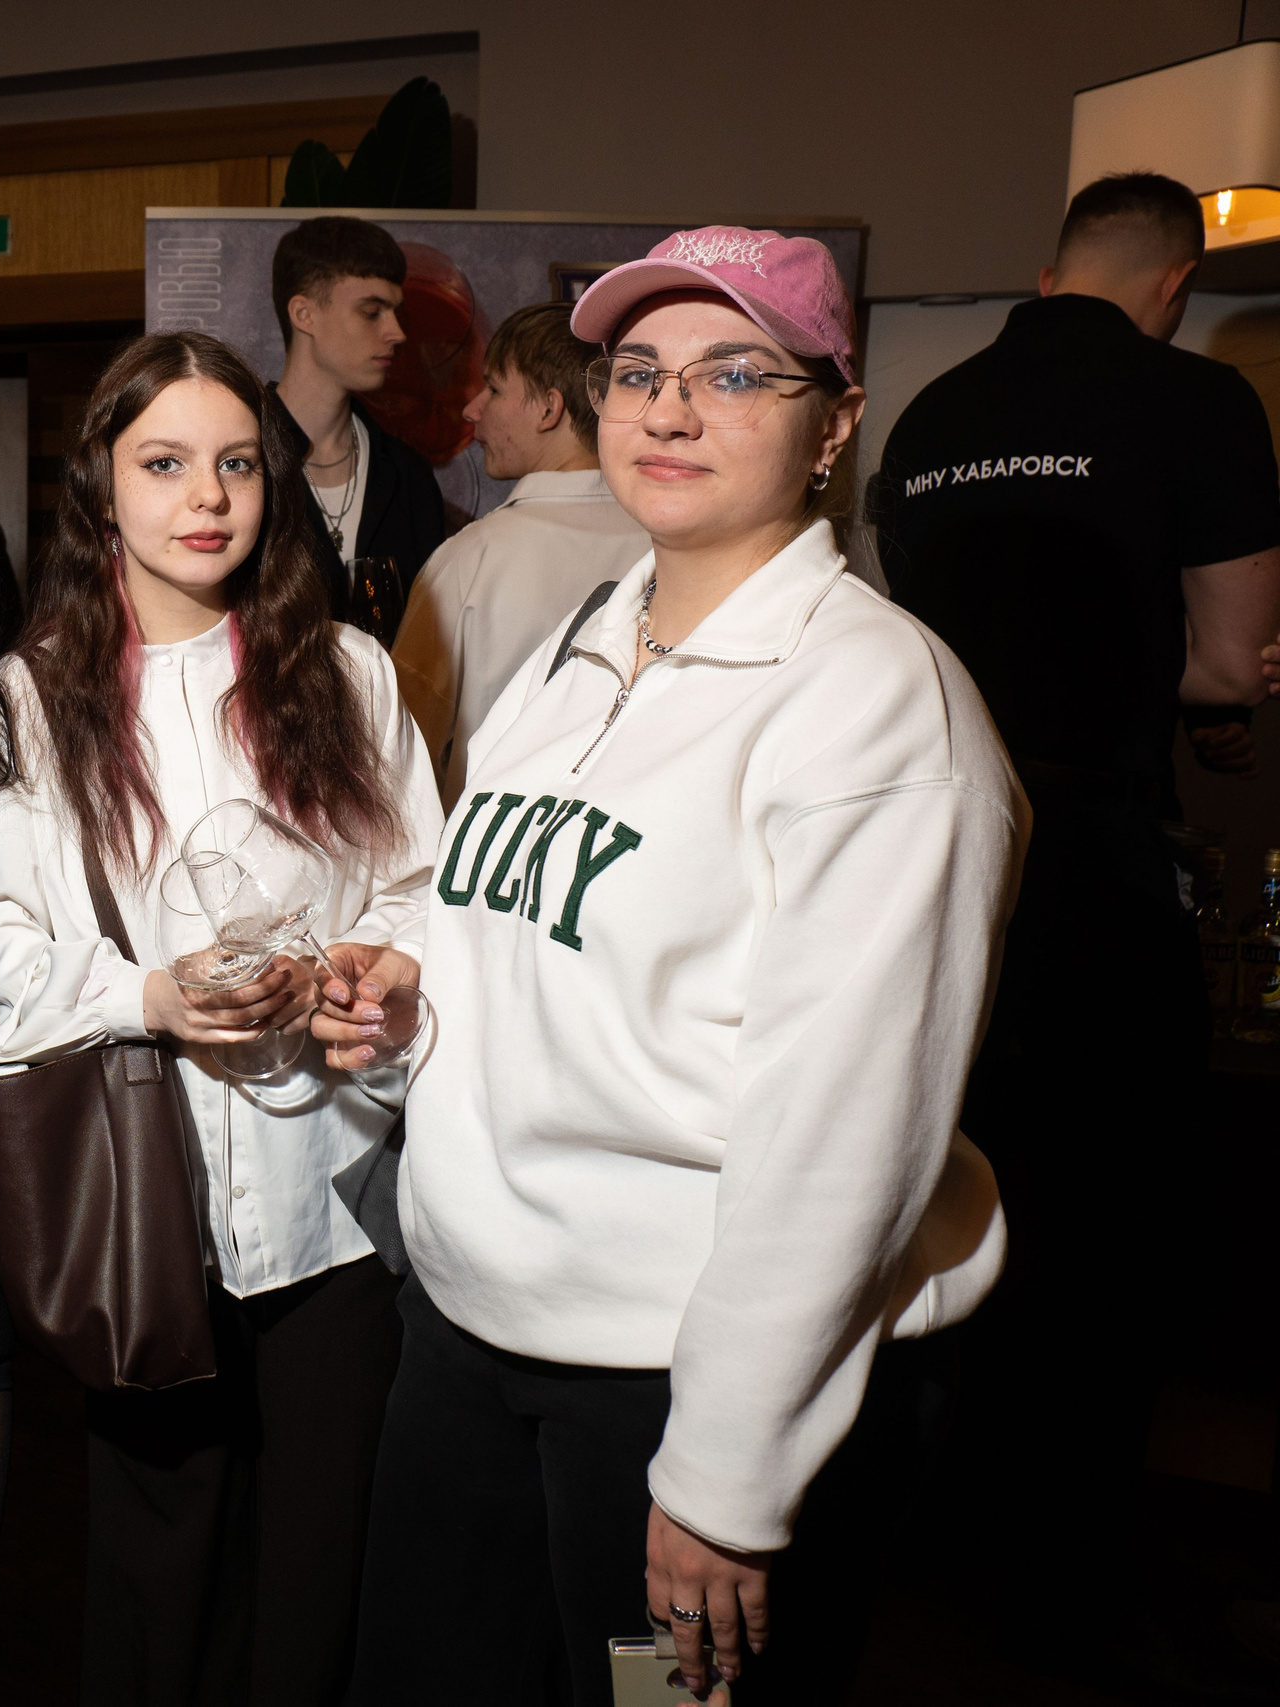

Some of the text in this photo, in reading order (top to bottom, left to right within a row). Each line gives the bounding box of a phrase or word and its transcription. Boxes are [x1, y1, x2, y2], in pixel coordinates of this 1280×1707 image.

[905, 455, 1093, 498] МНУ ХАБАРОВСК
[437, 791, 644, 952] UCKY
